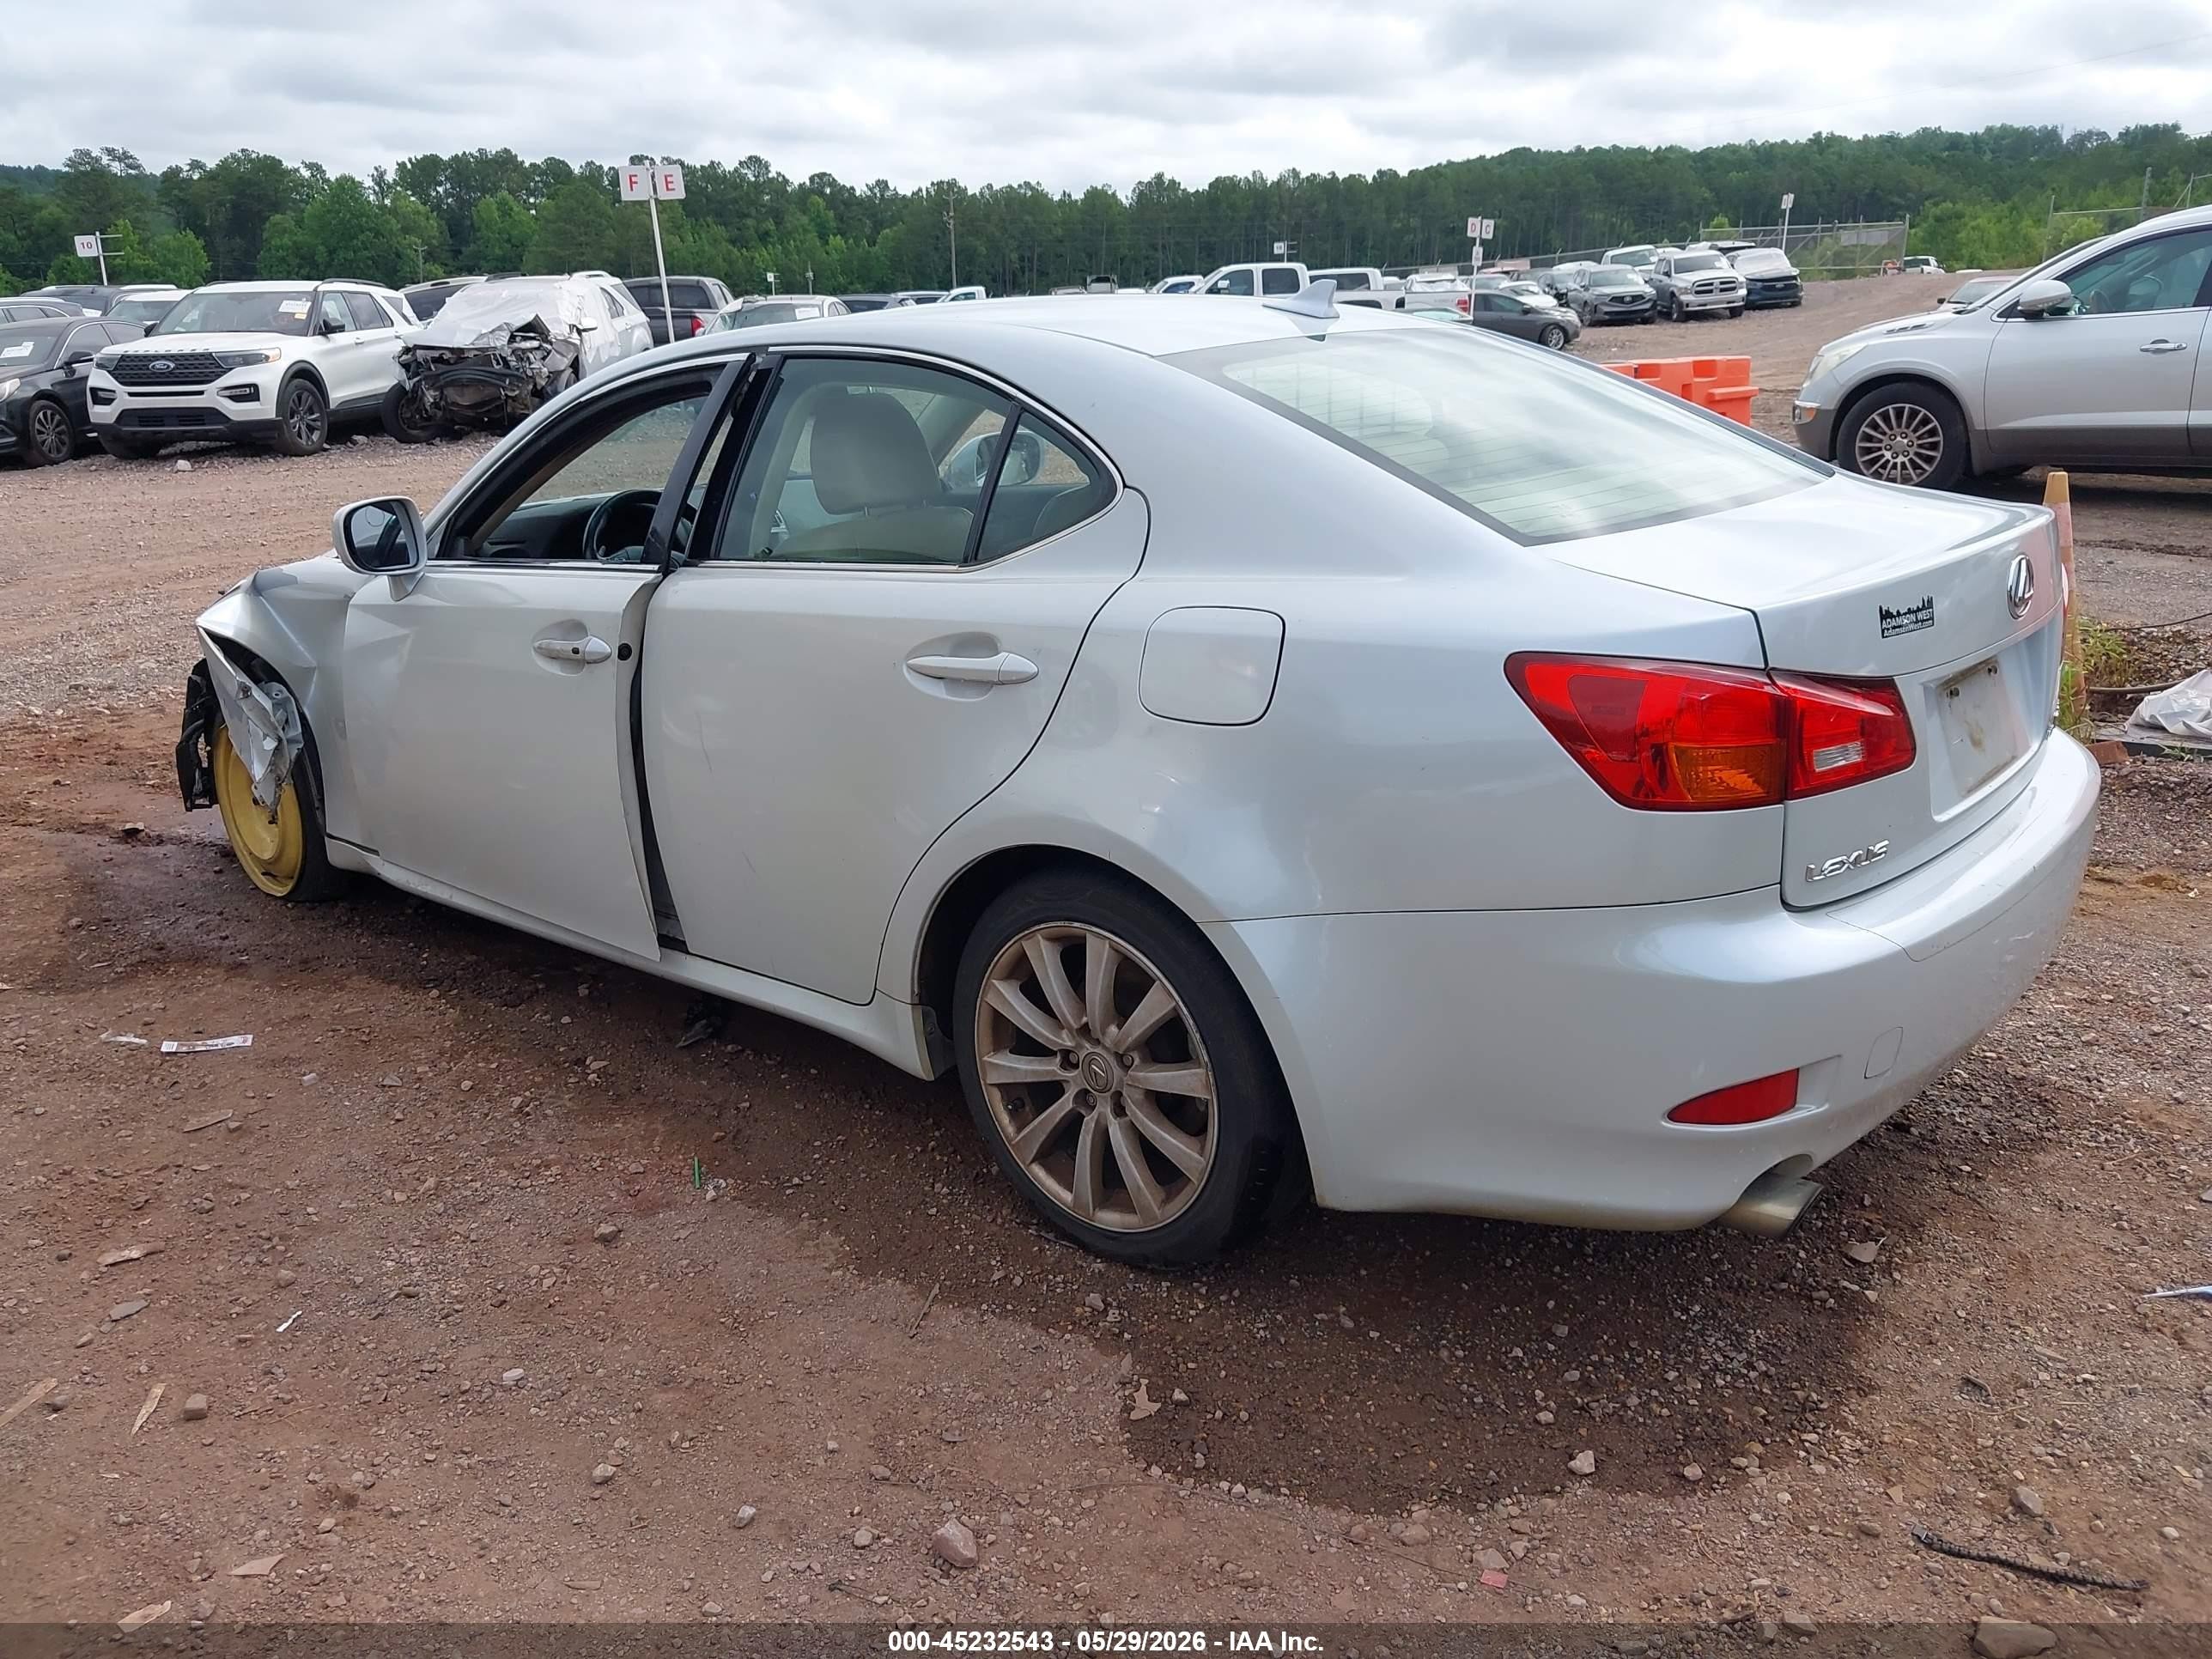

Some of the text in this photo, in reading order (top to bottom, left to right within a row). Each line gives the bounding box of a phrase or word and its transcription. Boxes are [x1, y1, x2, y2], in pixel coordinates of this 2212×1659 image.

[629, 174, 638, 192] F
[664, 174, 676, 192] E
[80, 241, 93, 250] 10
[1881, 608, 1933, 629] ADAMSON WEST
[1805, 840, 1889, 882] LEXUS
